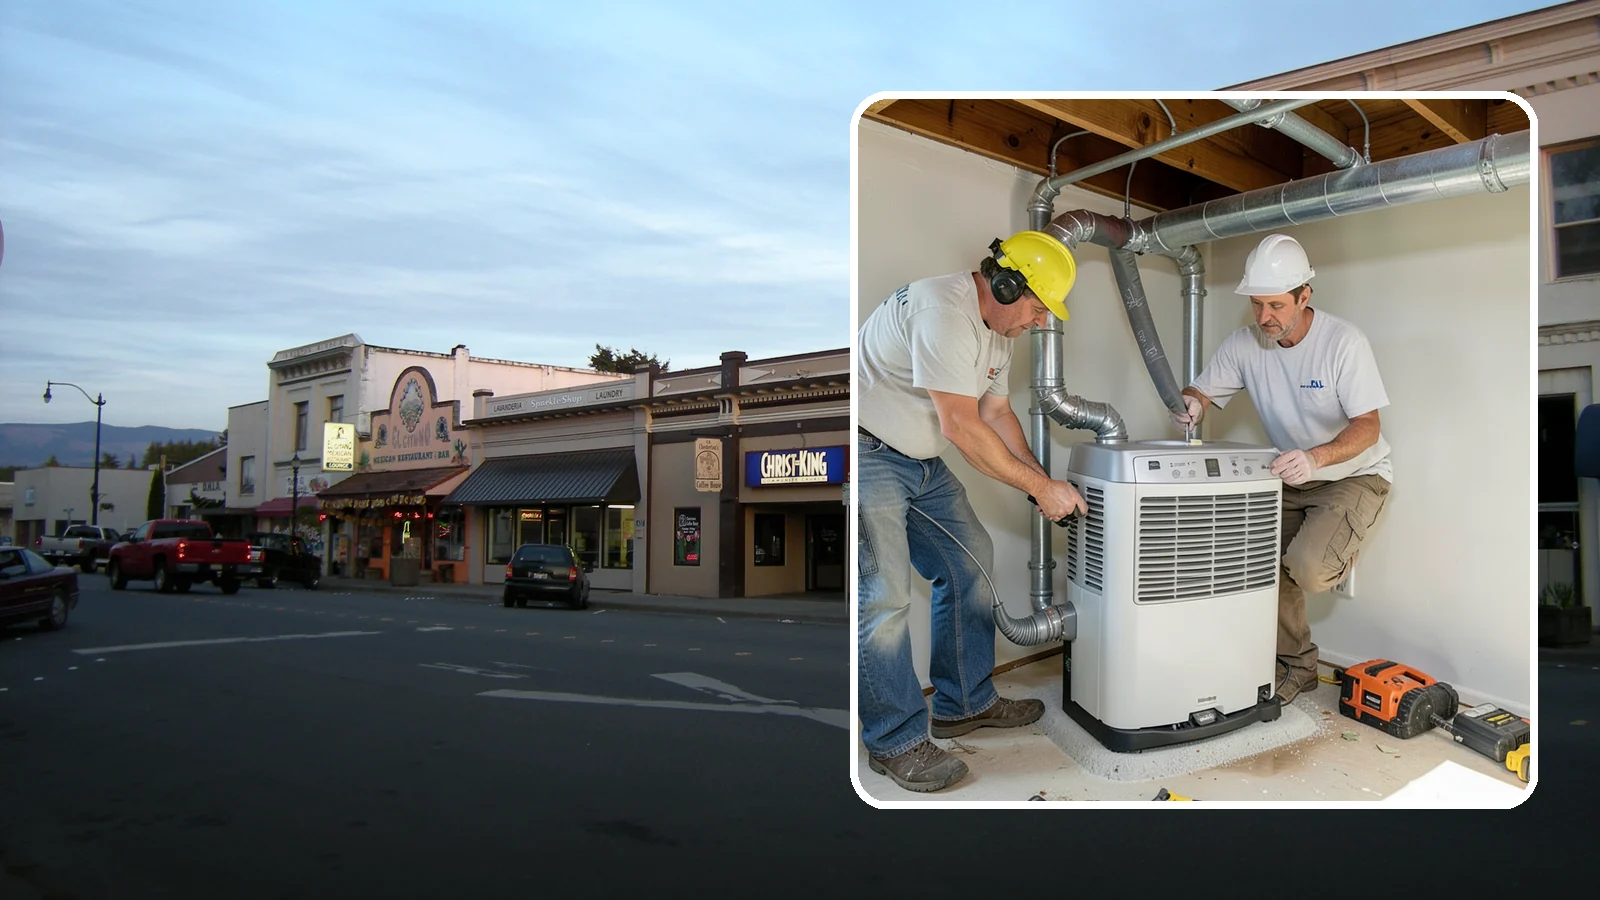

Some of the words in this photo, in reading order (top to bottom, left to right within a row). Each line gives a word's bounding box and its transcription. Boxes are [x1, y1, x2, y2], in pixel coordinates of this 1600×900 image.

[596, 389, 624, 399] LAUNDRY
[494, 402, 522, 412] LAVANDERIA
[531, 397, 560, 410] Sparkle
[562, 395, 582, 405] Shop
[374, 455, 396, 464] MEXICAN
[397, 451, 433, 463] RESTAURANT
[438, 450, 450, 460] BAR
[761, 452, 796, 478] CHRIST
[799, 450, 827, 475] KING
